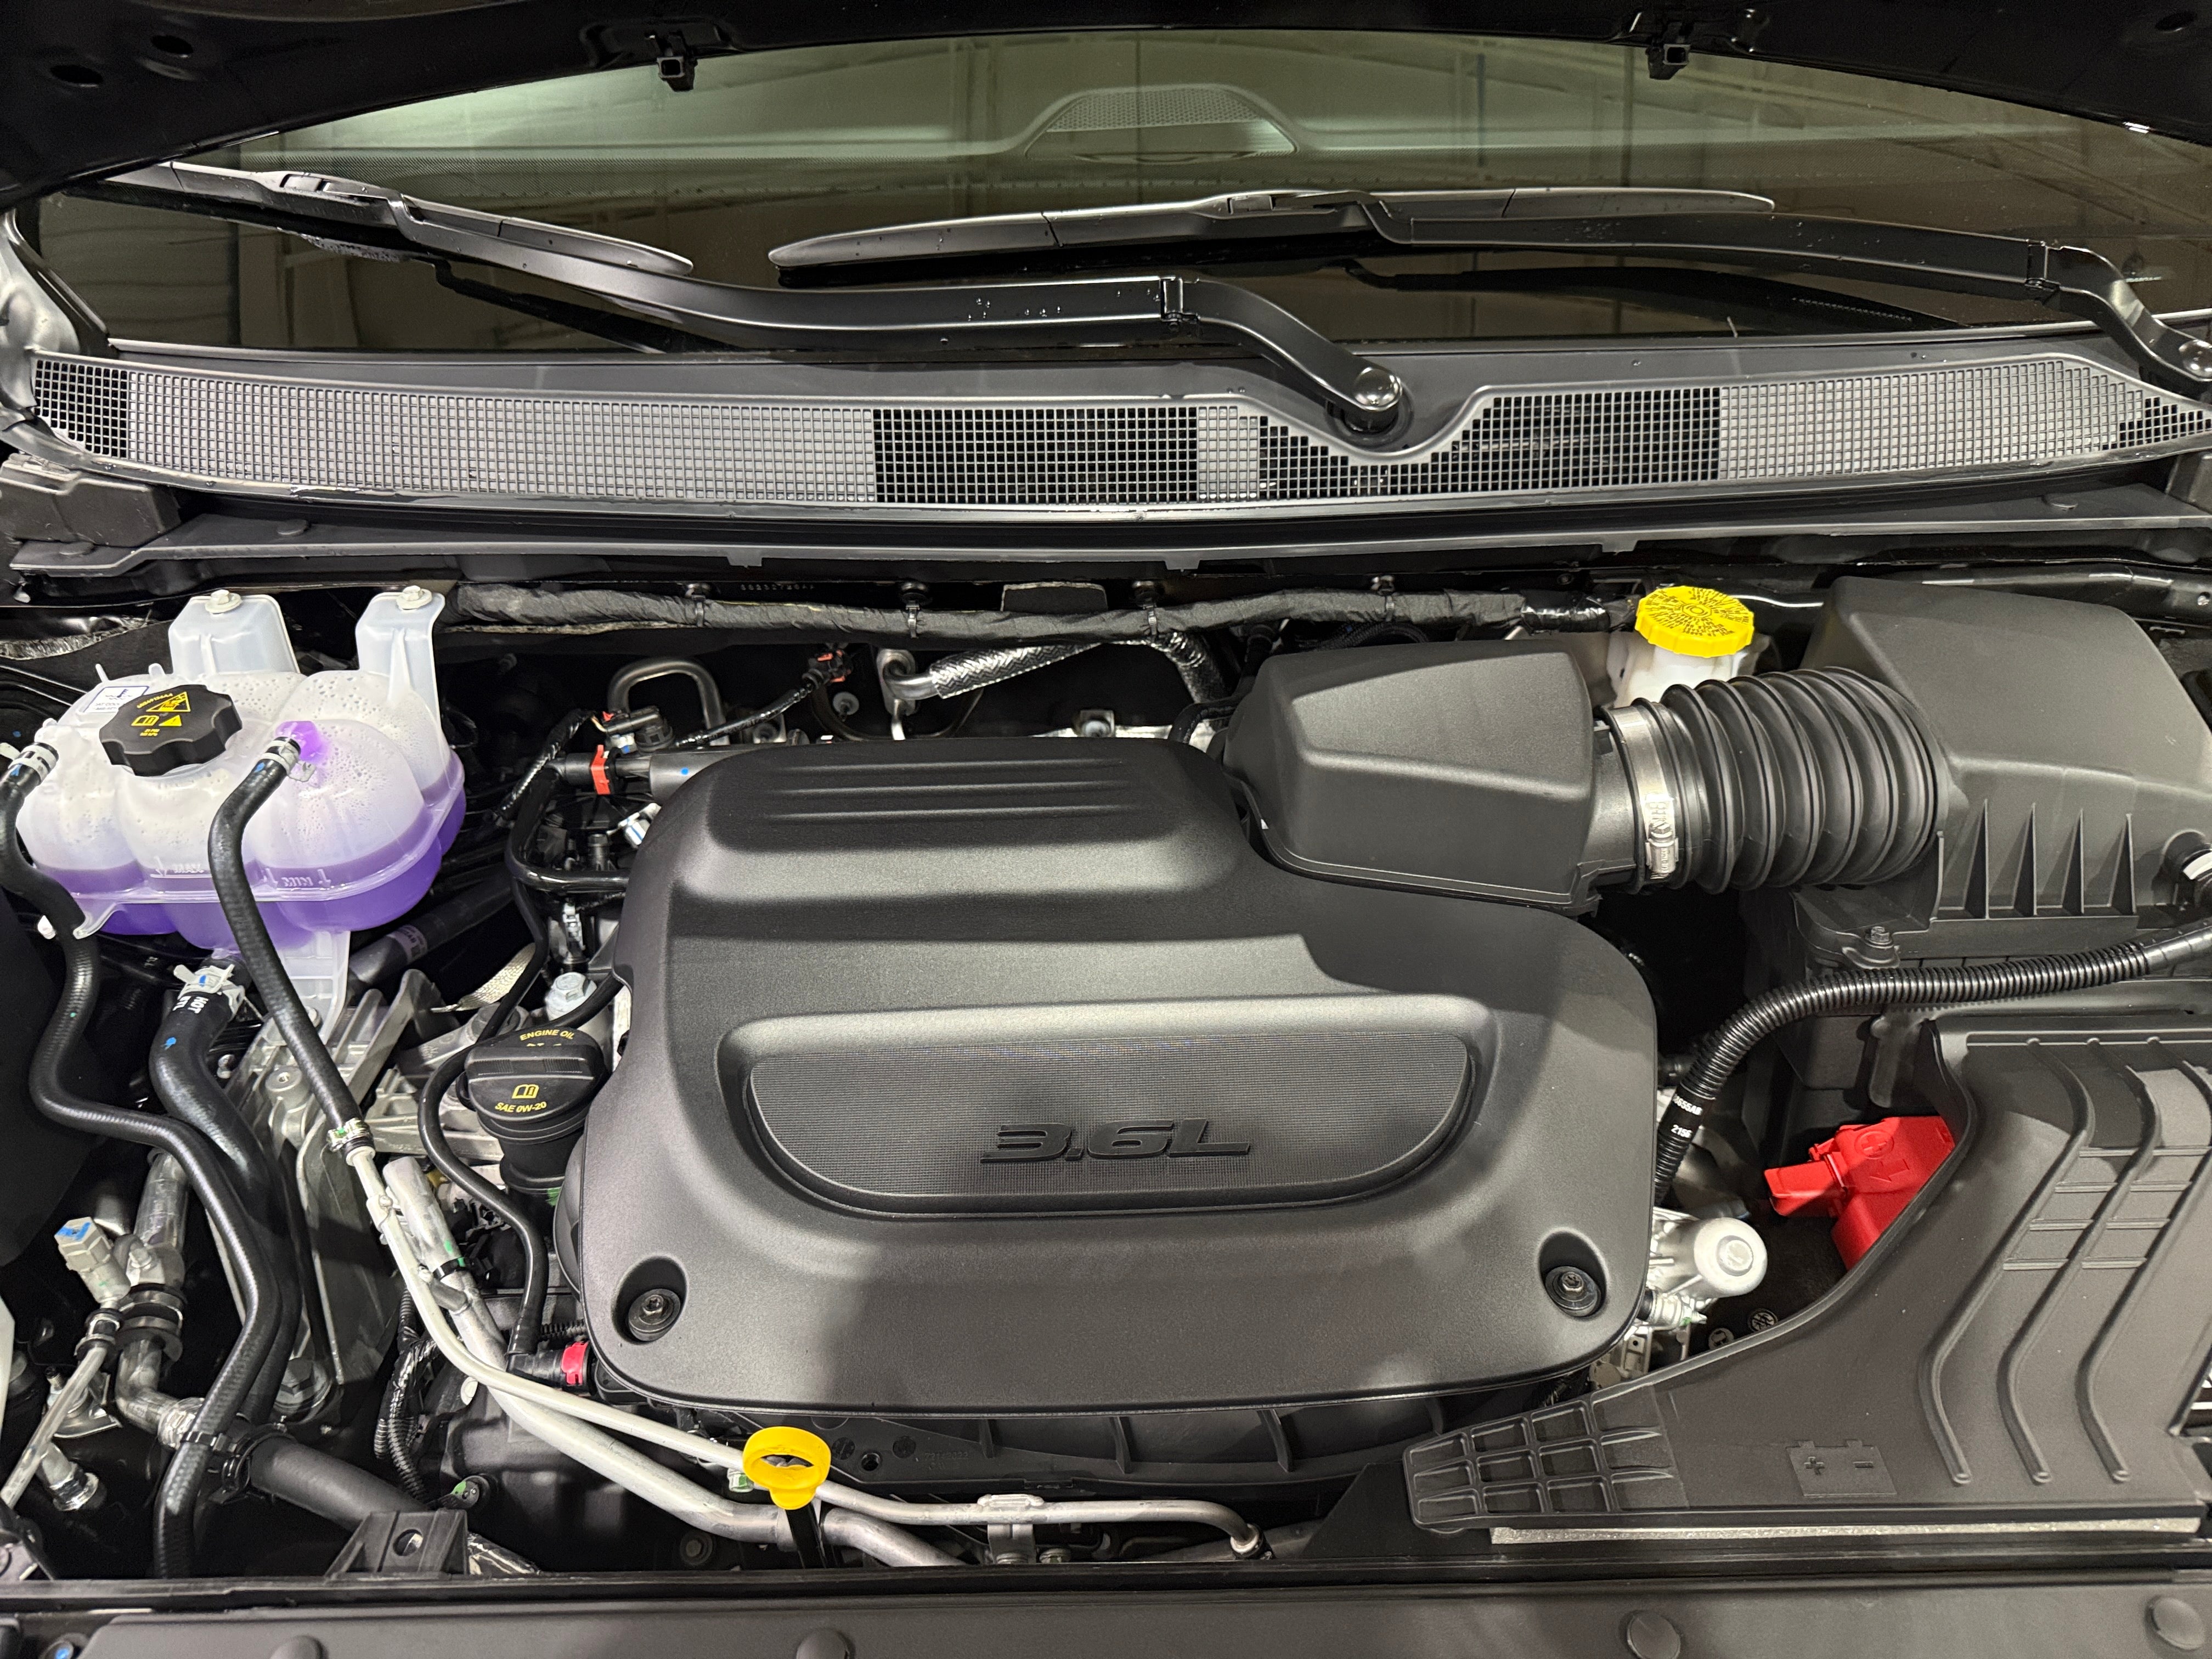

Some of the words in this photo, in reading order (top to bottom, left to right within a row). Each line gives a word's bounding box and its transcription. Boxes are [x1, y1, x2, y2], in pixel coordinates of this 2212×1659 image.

[187, 996, 209, 1014] HOT
[520, 1029, 560, 1041] ENGINE
[560, 1030, 575, 1040] OIL
[495, 1102, 516, 1113] SAE
[516, 1101, 547, 1113] 0W-20
[980, 1118, 1250, 1163] 3.6L
